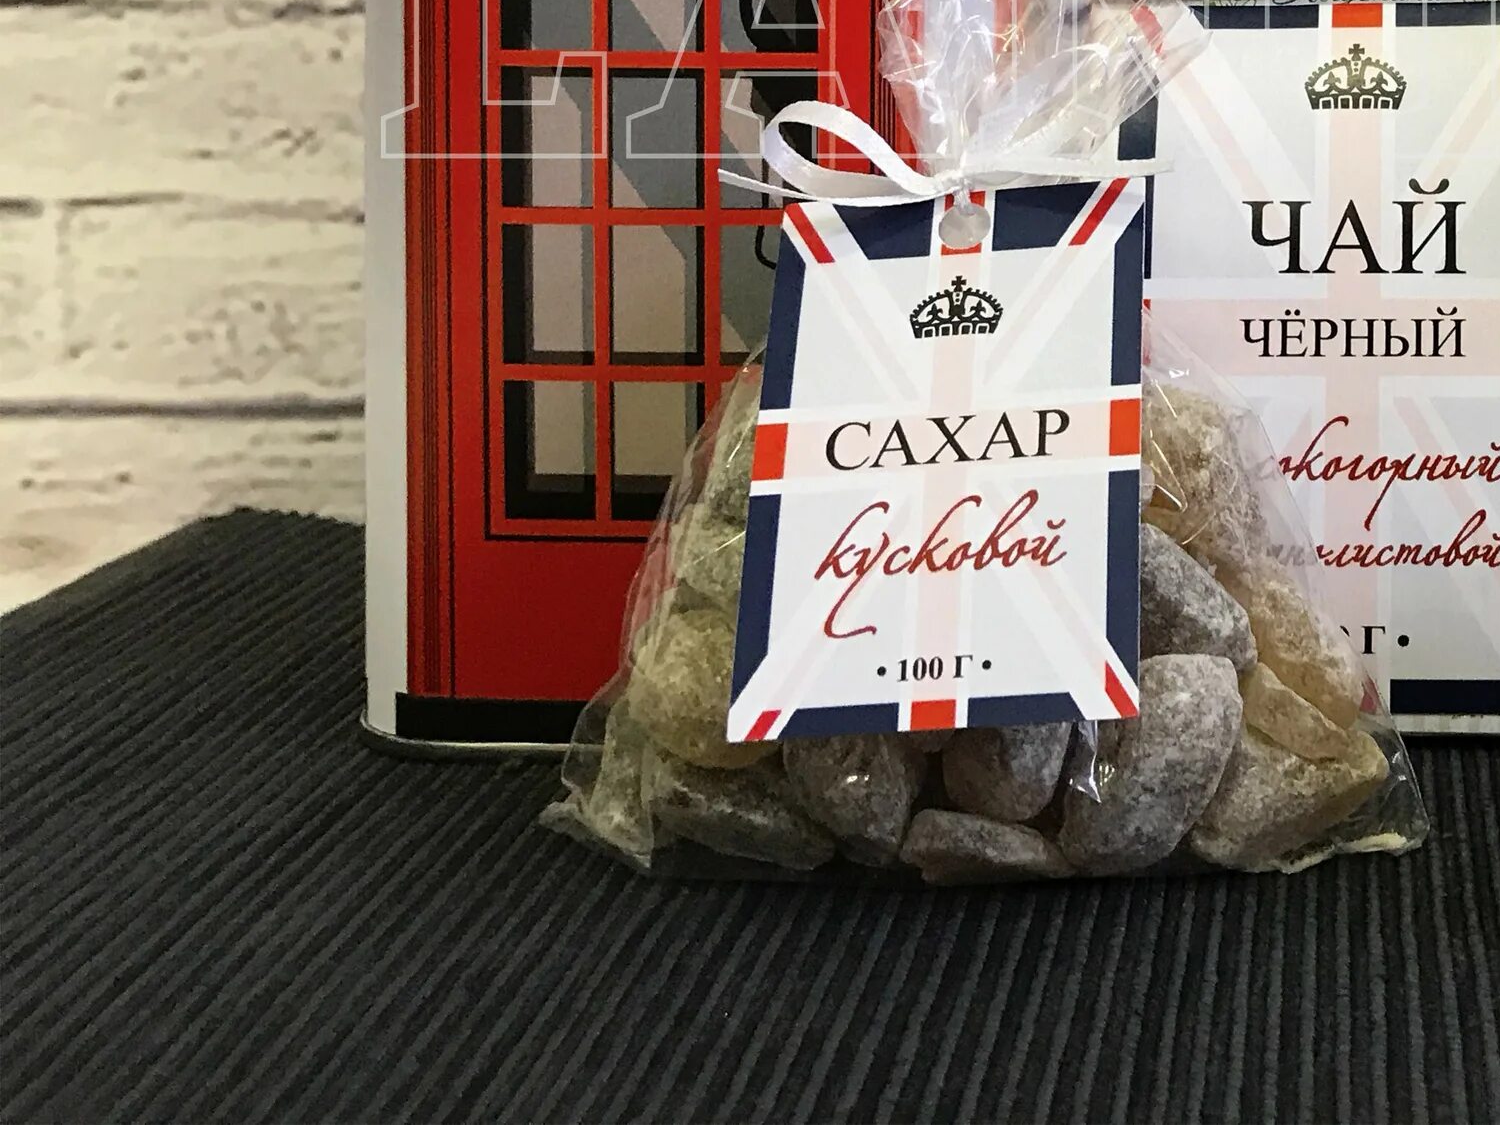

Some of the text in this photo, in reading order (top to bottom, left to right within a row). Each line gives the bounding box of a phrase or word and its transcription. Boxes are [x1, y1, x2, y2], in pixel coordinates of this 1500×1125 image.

[1242, 178, 1467, 275] ЧАЙ
[1240, 306, 1466, 358] ЧЁРНЫЙ
[825, 409, 1070, 471] САХАР
[814, 489, 1068, 639] кусковой
[898, 654, 974, 682] 100 Г
